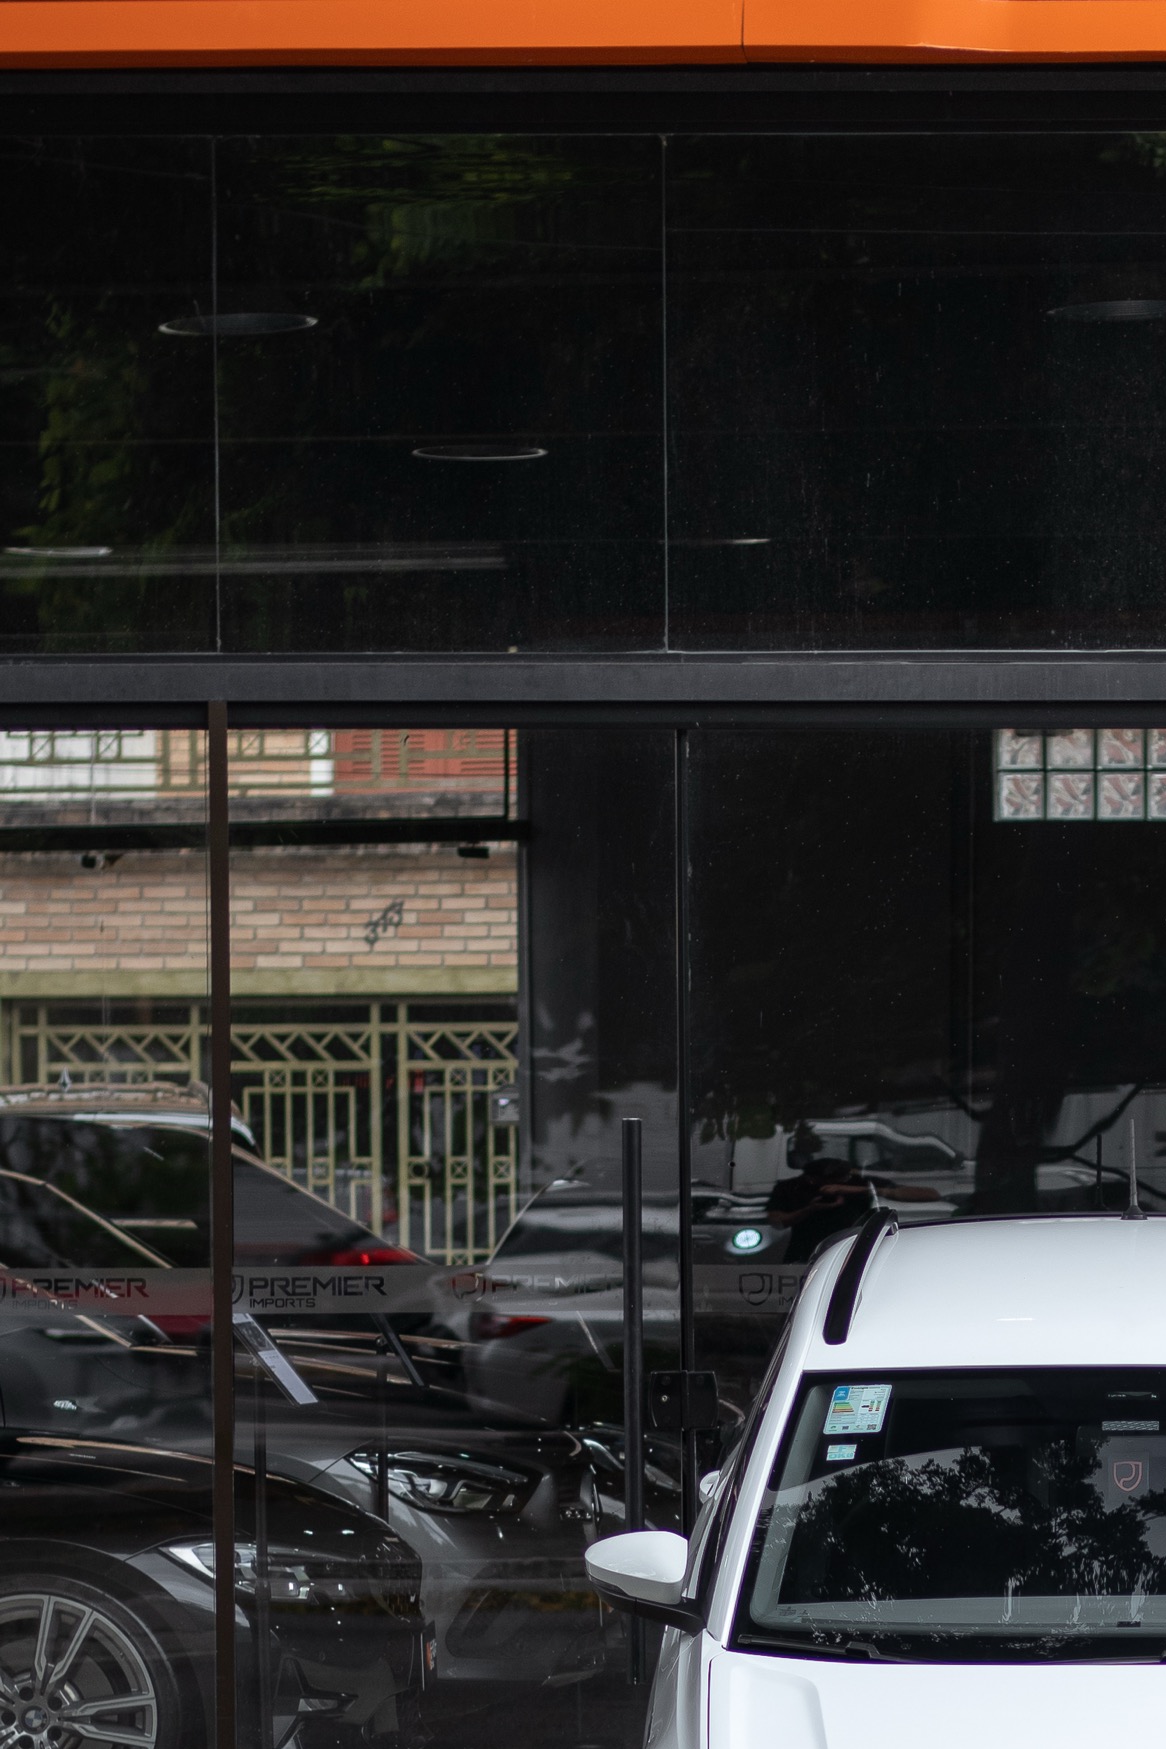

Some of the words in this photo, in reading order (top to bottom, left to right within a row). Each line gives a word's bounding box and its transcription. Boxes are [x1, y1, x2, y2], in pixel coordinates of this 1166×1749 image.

[11, 1277, 149, 1298] PREMIER
[249, 1276, 387, 1296] PREMIER
[249, 1297, 316, 1308] IMPORTS
